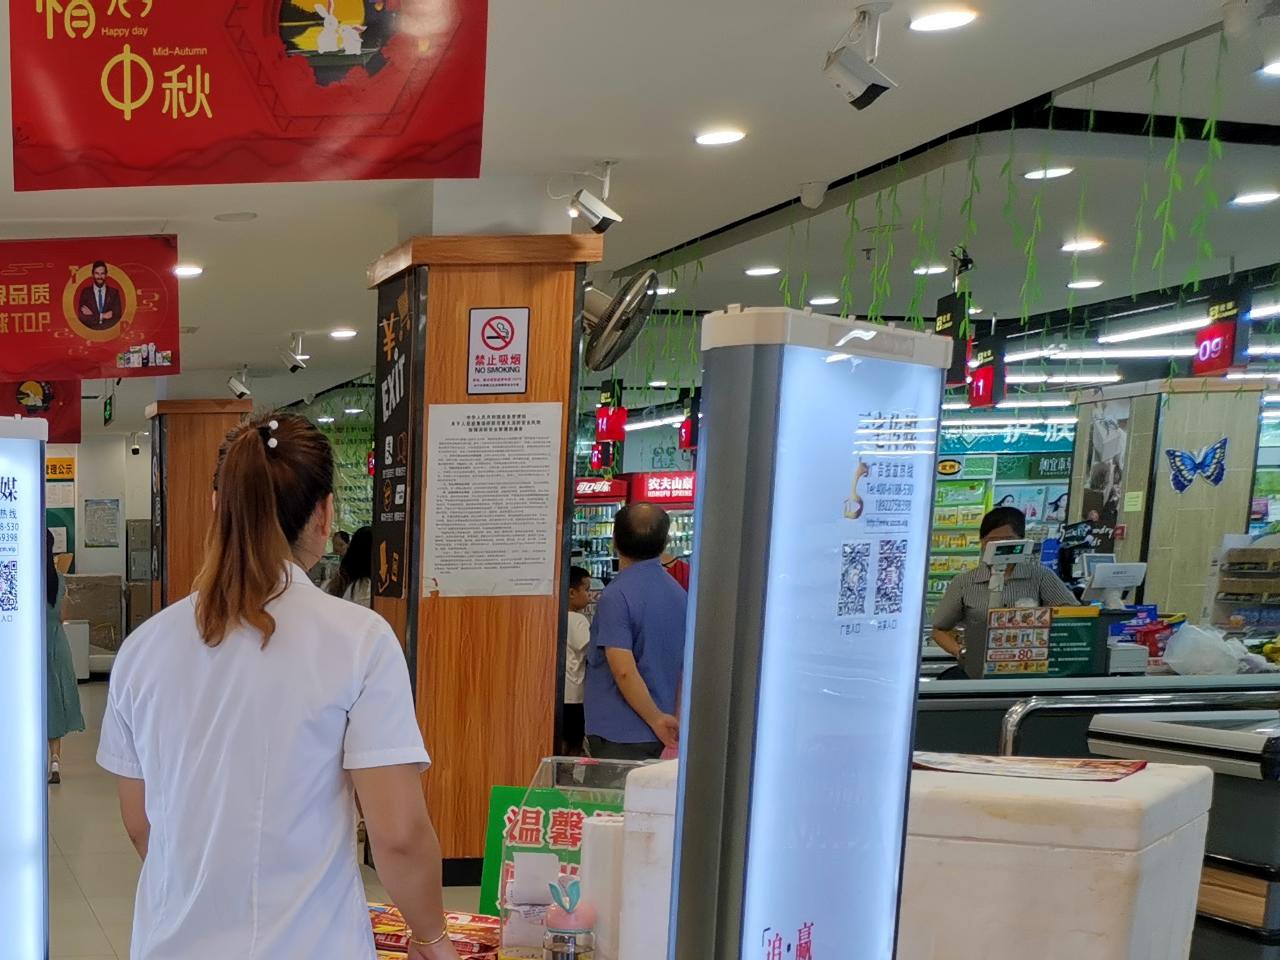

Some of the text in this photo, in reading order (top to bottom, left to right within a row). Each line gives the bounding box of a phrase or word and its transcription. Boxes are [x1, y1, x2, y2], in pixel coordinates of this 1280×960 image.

[101, 26, 148, 37] Happy day
[153, 47, 208, 56] Mid-Autumn
[101, 44, 213, 121] 中秋
[1198, 336, 1225, 362] 09
[474, 354, 521, 366] 禁止吸烟
[487, 366, 521, 374] SMOKING
[598, 418, 608, 432] 14
[576, 481, 612, 494] 可口可乐
[647, 476, 694, 490] 农夫山泉
[503, 806, 623, 849] 温馨
